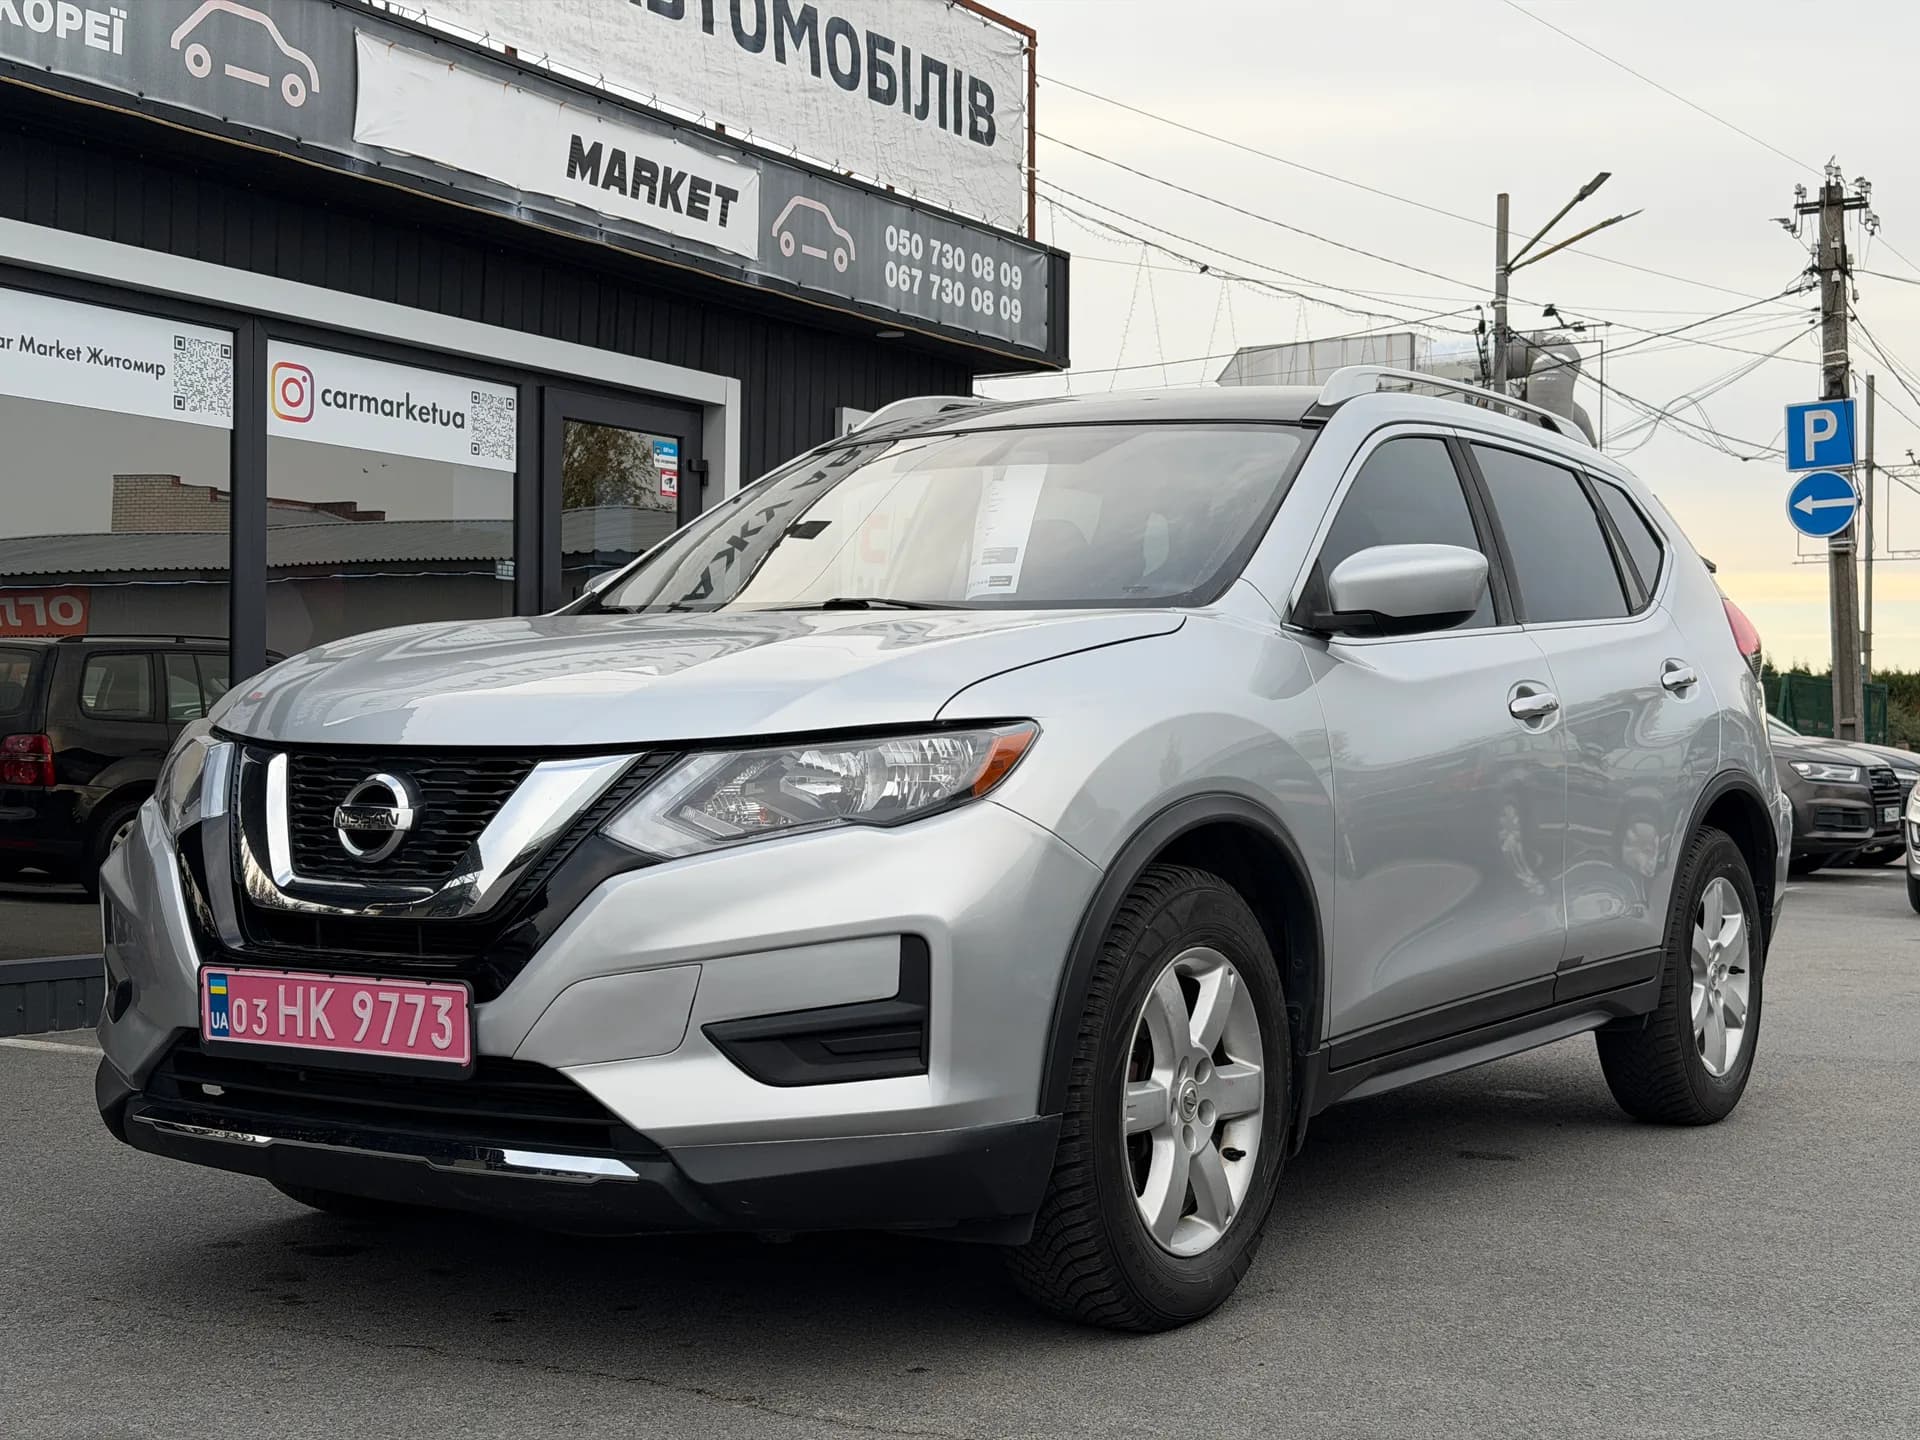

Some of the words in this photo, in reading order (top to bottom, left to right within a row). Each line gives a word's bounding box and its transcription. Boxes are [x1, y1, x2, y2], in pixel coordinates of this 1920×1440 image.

[629, 0, 997, 147] ОМОБІЛІВ
[566, 134, 739, 228] MARKET
[885, 225, 923, 260] 050
[929, 238, 966, 273] 730
[971, 252, 995, 282] 08
[1000, 262, 1022, 291] 09
[885, 261, 923, 295] 067
[929, 273, 966, 307] 730
[971, 286, 995, 316] 08
[1000, 295, 1022, 324] 09
[19, 334, 82, 362] Market
[86, 346, 166, 380] Житомир
[321, 388, 466, 430] carmarketua
[1804, 409, 1838, 462] P
[338, 811, 400, 827] NISSAN
[211, 1011, 229, 1030] UA
